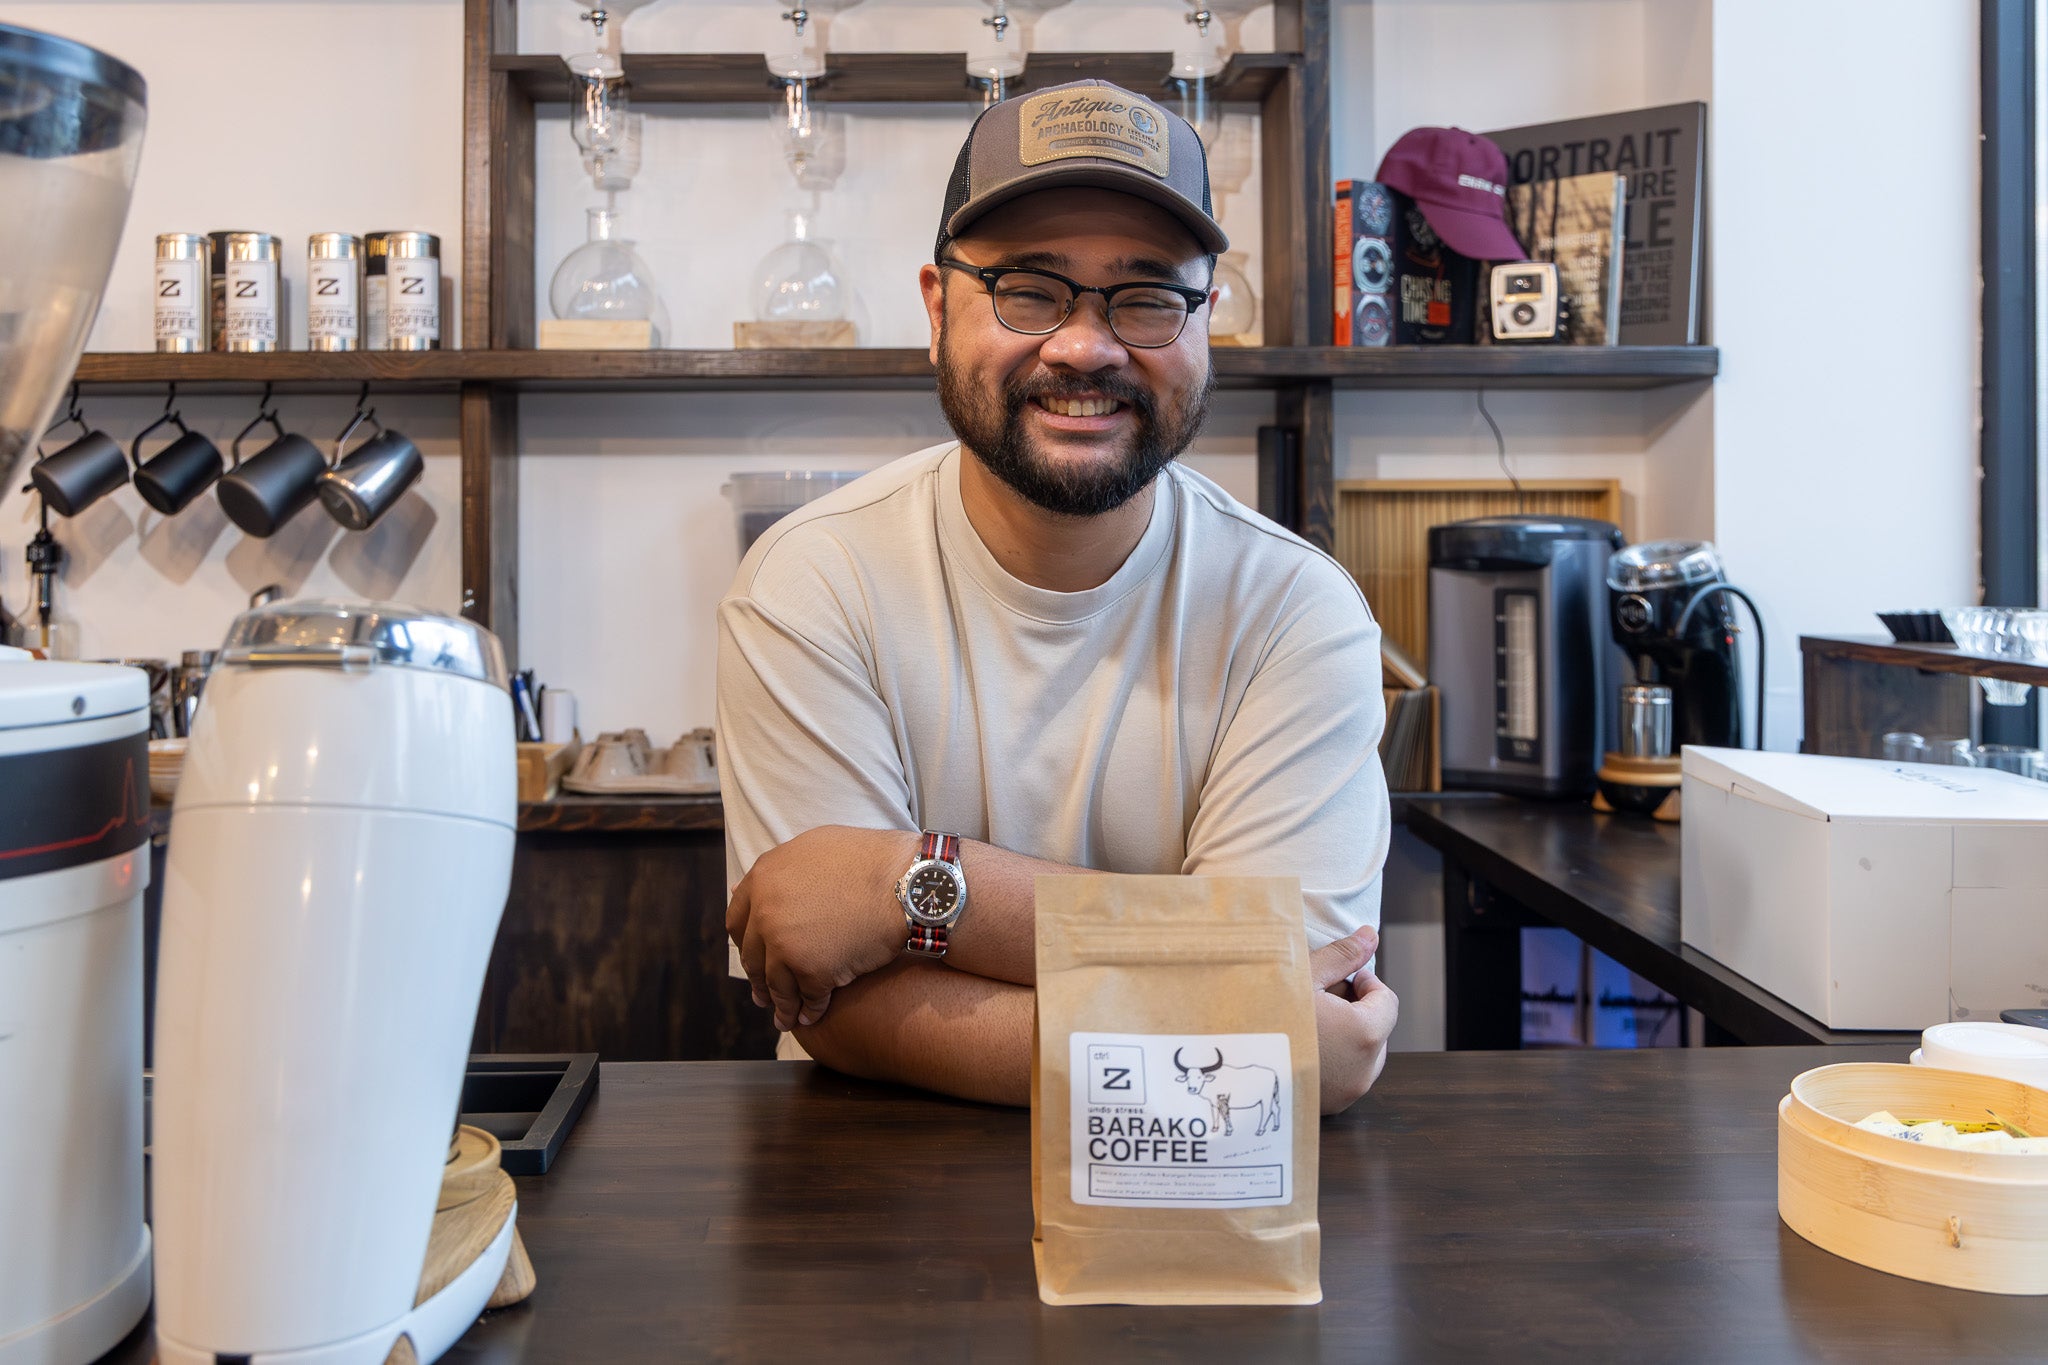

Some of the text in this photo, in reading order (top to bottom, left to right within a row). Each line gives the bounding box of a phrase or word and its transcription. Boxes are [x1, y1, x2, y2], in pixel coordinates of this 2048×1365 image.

[1032, 97, 1126, 127] Antique
[1038, 120, 1123, 139] ARCHAEOLOGY
[1505, 128, 1681, 185] ORTRAIT
[160, 280, 180, 297] Z
[236, 281, 257, 297] Z
[318, 278, 339, 295] Z
[402, 278, 423, 294] Z
[1103, 1068, 1130, 1089] Z
[1089, 1116, 1206, 1138] BARAKO
[1089, 1138, 1208, 1162] COFFEE
